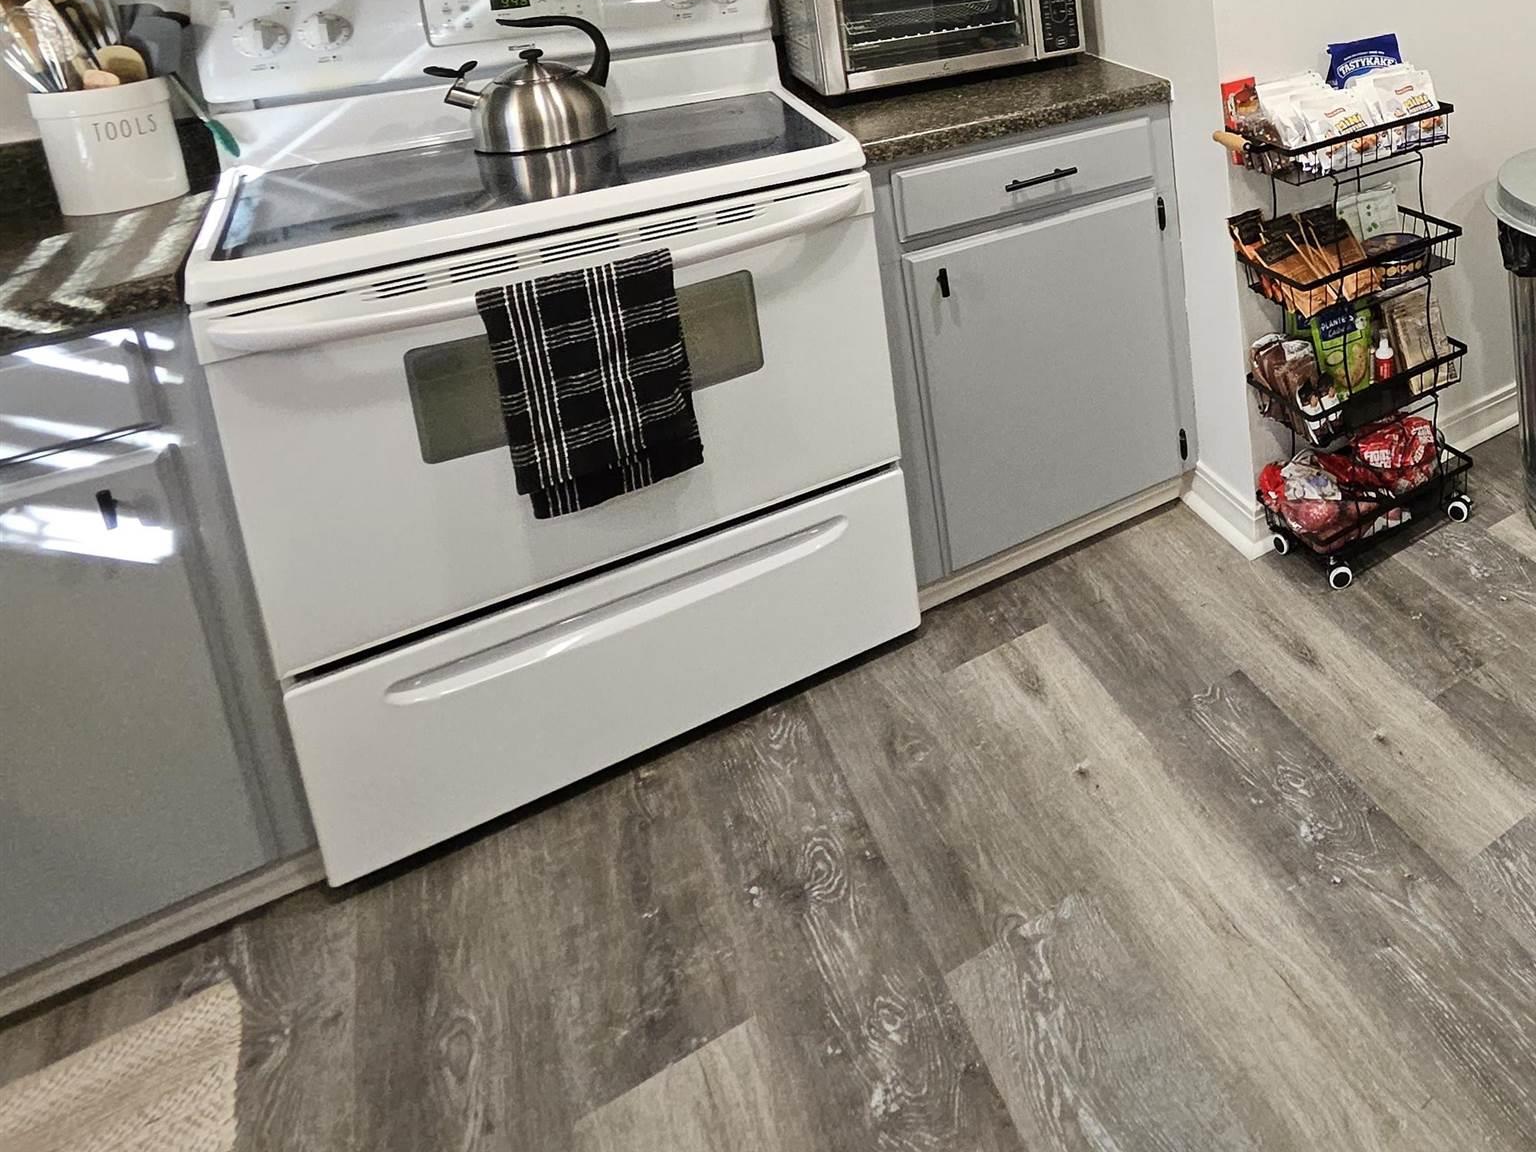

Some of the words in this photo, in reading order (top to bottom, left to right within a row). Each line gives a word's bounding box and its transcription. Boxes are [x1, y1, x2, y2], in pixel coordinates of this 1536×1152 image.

[1339, 56, 1396, 76] TASTYKAKE
[91, 114, 157, 142] TOOLS
[1321, 314, 1355, 331] PLANTES
